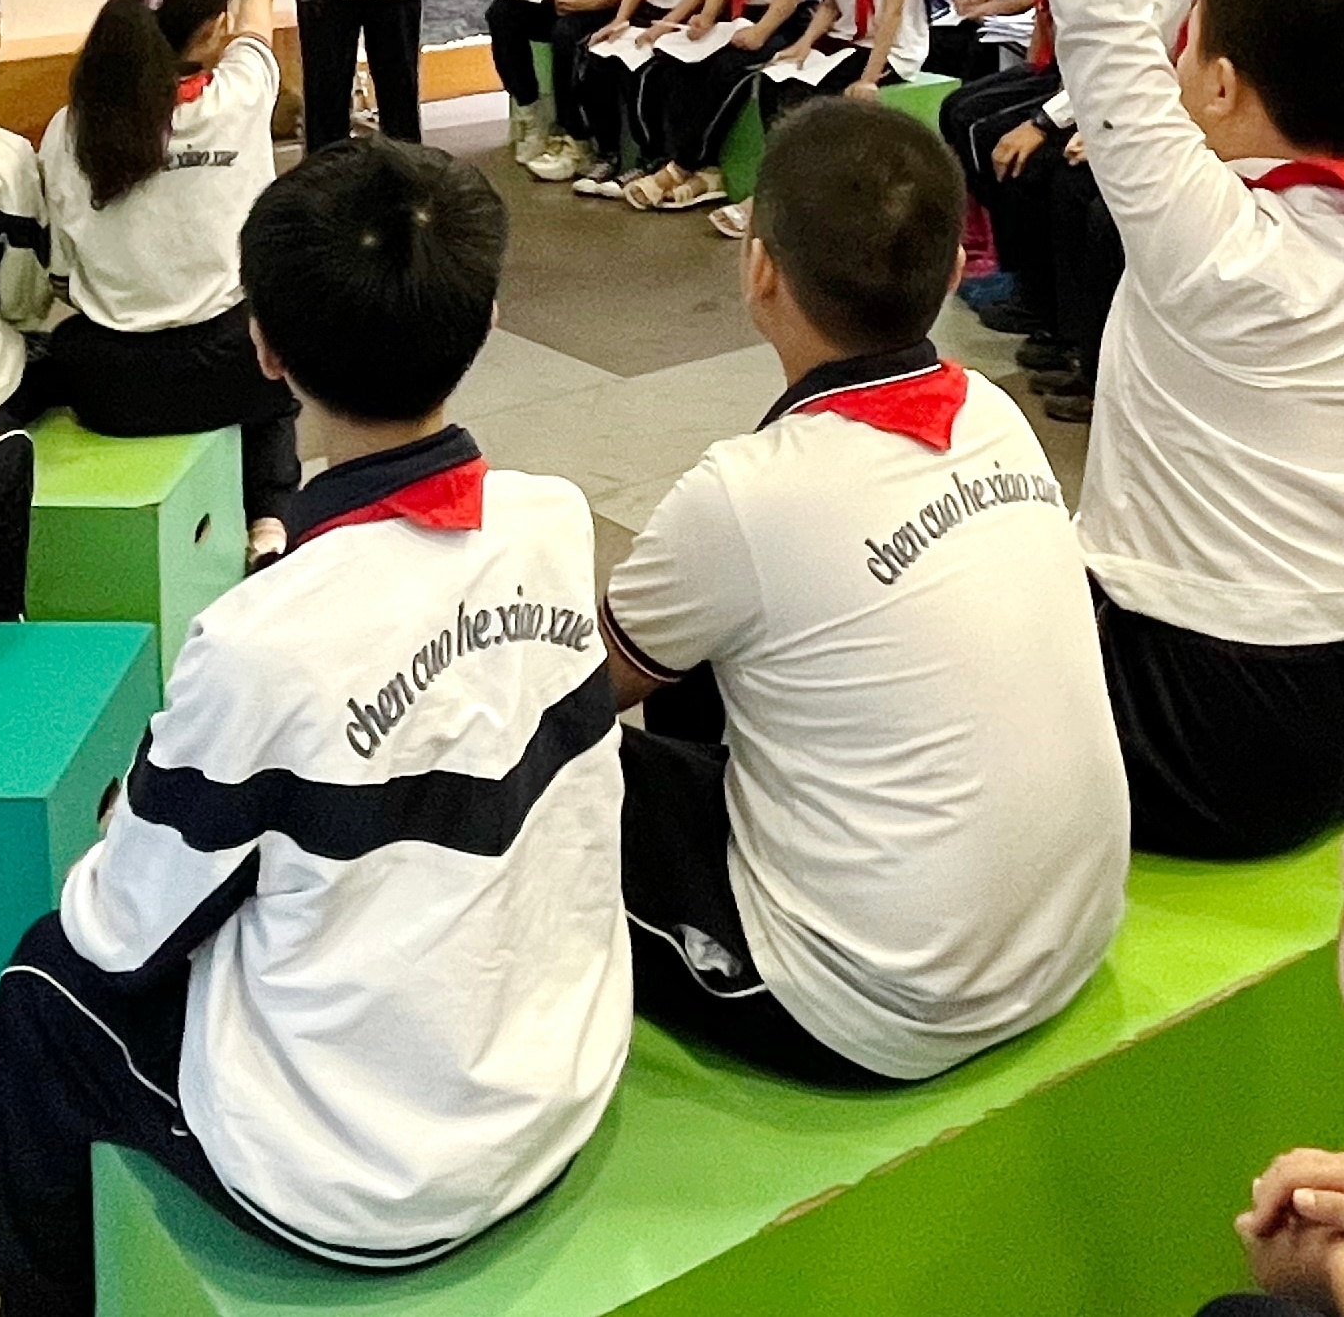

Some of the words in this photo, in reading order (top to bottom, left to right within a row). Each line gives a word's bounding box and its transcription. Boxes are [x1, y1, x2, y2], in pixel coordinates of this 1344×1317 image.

[864, 521, 930, 585] chen
[919, 493, 963, 540] cuo
[951, 471, 990, 517] he
[985, 460, 1030, 505] xiao
[346, 671, 416, 760] chen
[412, 629, 452, 692] cuo
[457, 599, 492, 658] he
[494, 584, 544, 645] xiao
[540, 605, 595, 653] xue
